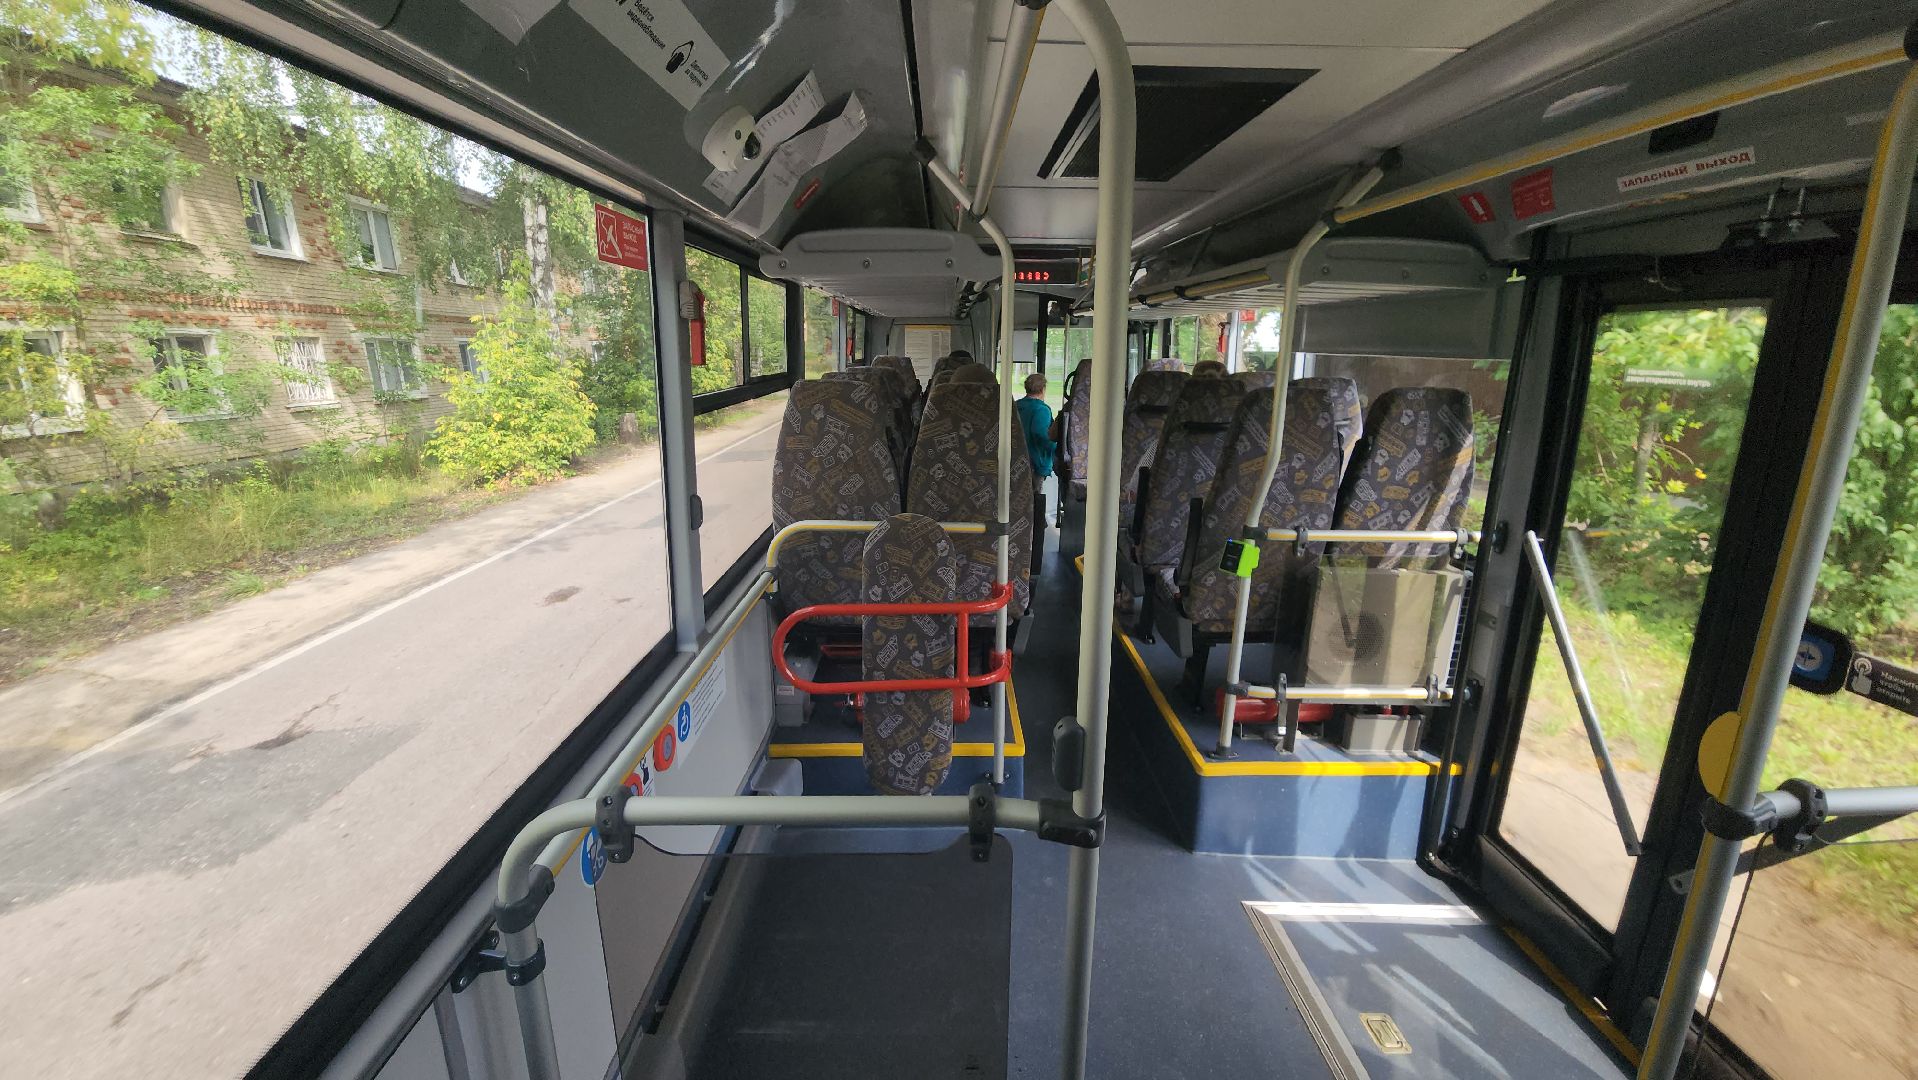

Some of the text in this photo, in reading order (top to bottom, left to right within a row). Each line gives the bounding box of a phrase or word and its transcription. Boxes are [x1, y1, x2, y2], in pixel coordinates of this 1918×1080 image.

[634, 0, 654, 22] Ведётся
[1622, 152, 1751, 188] ЗАПАСНЫЙ ВЫХОД
